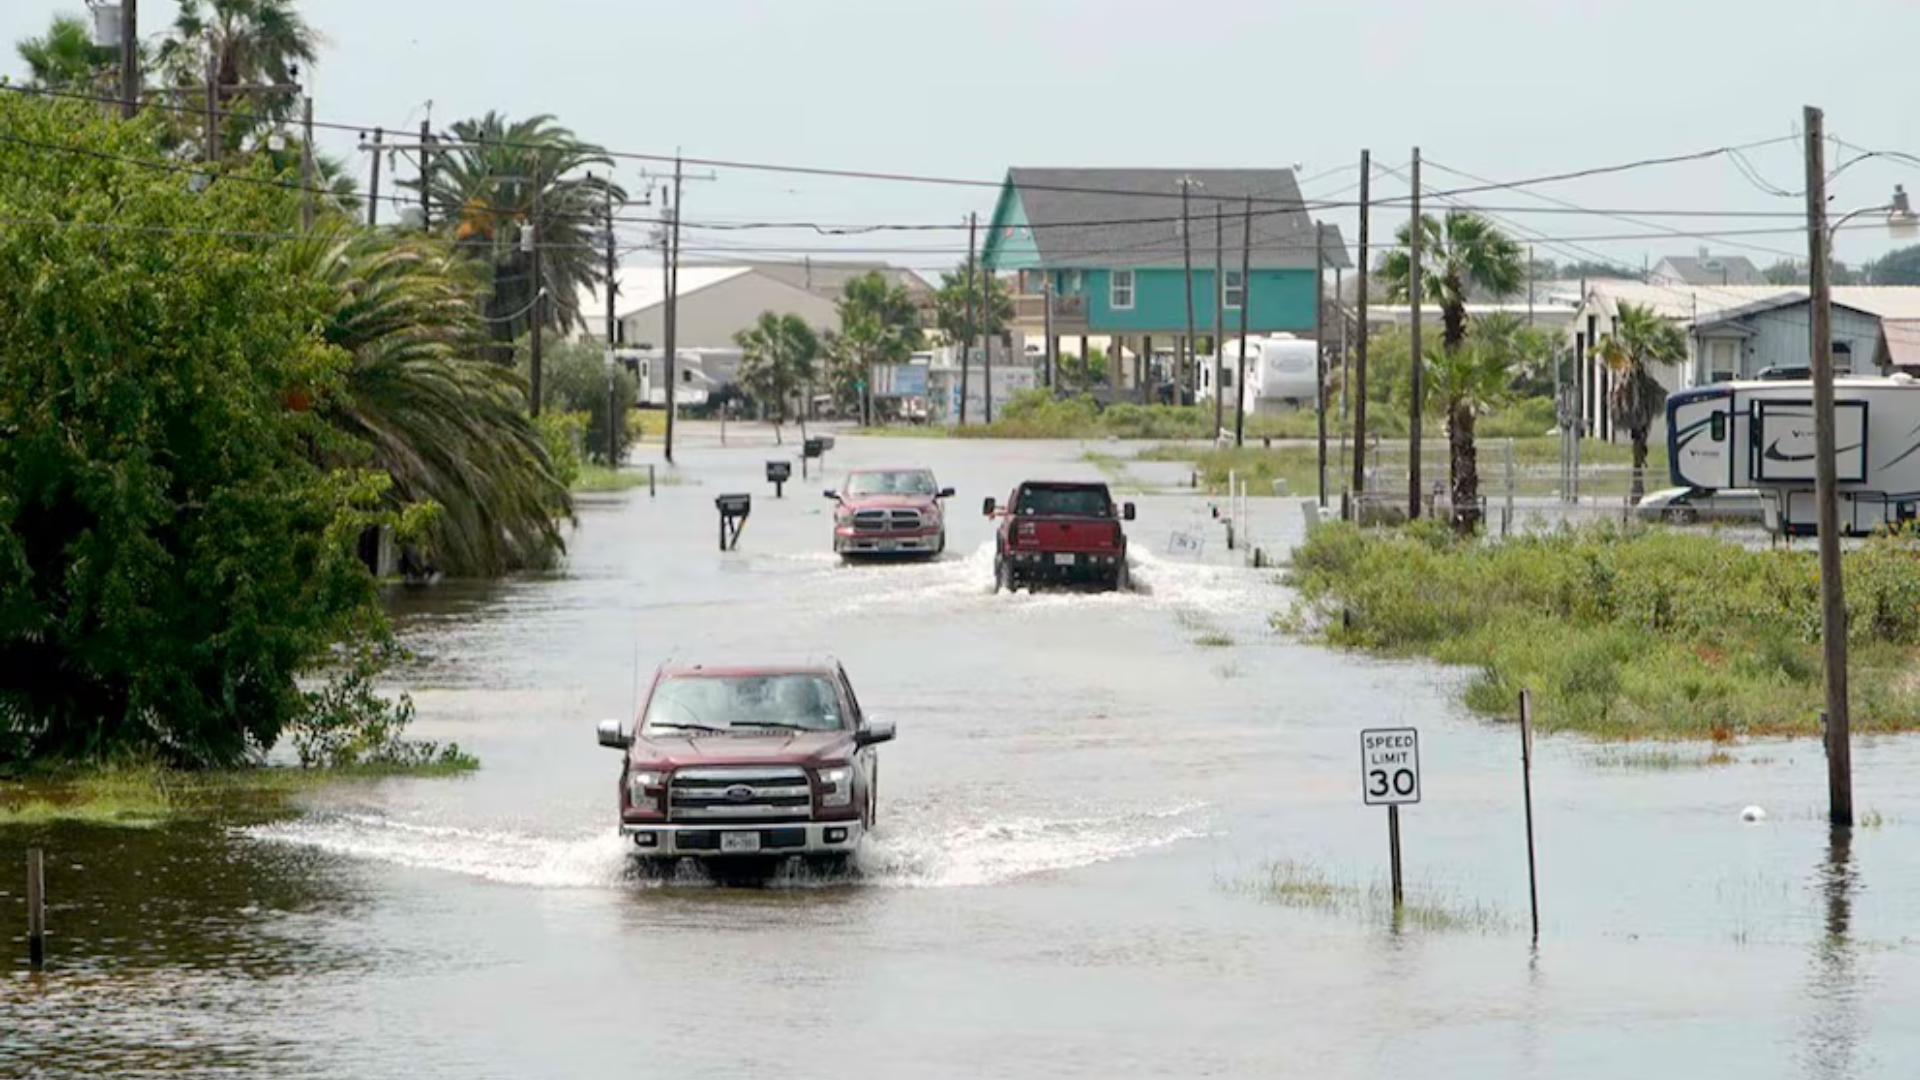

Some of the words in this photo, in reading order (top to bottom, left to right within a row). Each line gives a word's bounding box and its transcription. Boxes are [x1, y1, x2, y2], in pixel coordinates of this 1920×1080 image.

[1366, 735, 1413, 749] SPEED
[1371, 751, 1408, 764] LIMIT
[1369, 768, 1415, 797] 30
